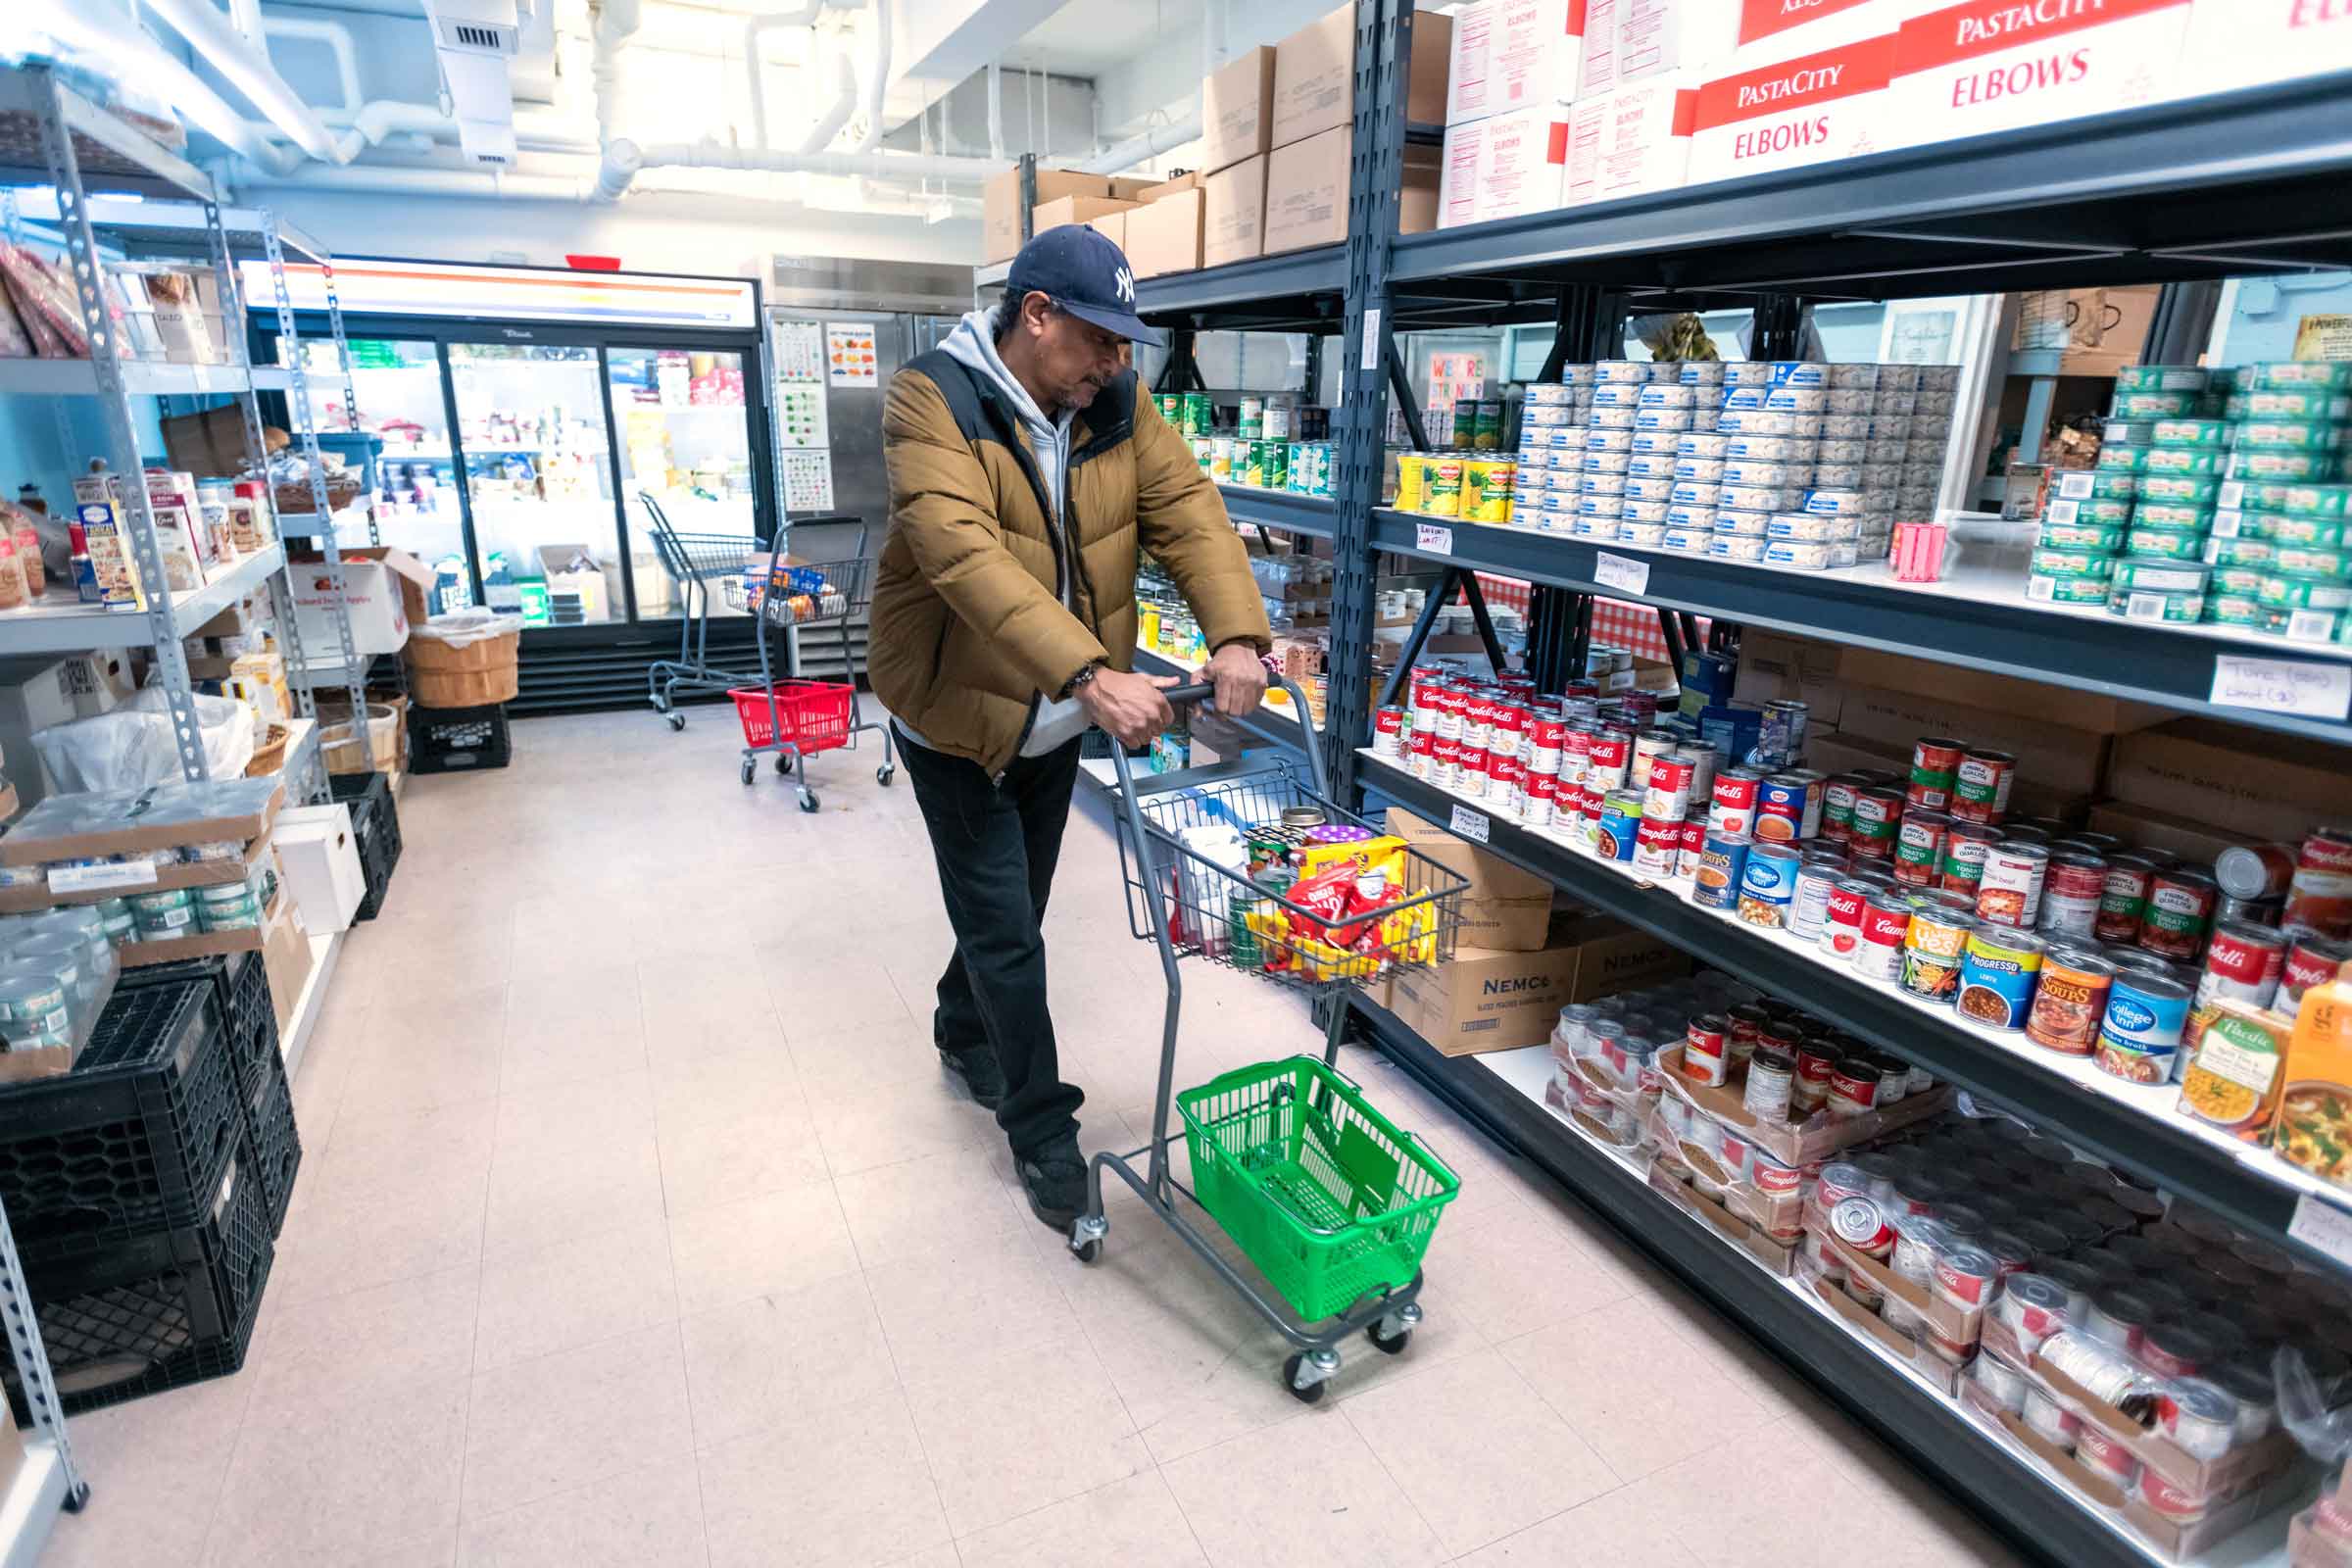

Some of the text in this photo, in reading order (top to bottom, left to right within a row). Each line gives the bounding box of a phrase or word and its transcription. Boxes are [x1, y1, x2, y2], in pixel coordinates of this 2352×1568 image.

[1737, 64, 1846, 109] PASTACITY
[1951, 47, 2090, 109] ELBOWS
[1734, 116, 1830, 160] ELBOWS
[1714, 785, 1743, 799] pbell's
[1956, 864, 1984, 874] TOMAT
[1970, 955, 2019, 972] PROGRESSO
[2041, 977, 2090, 1004] SOUPS
[2110, 1000, 2153, 1024] College
[2115, 1015, 2134, 1029] Inn
